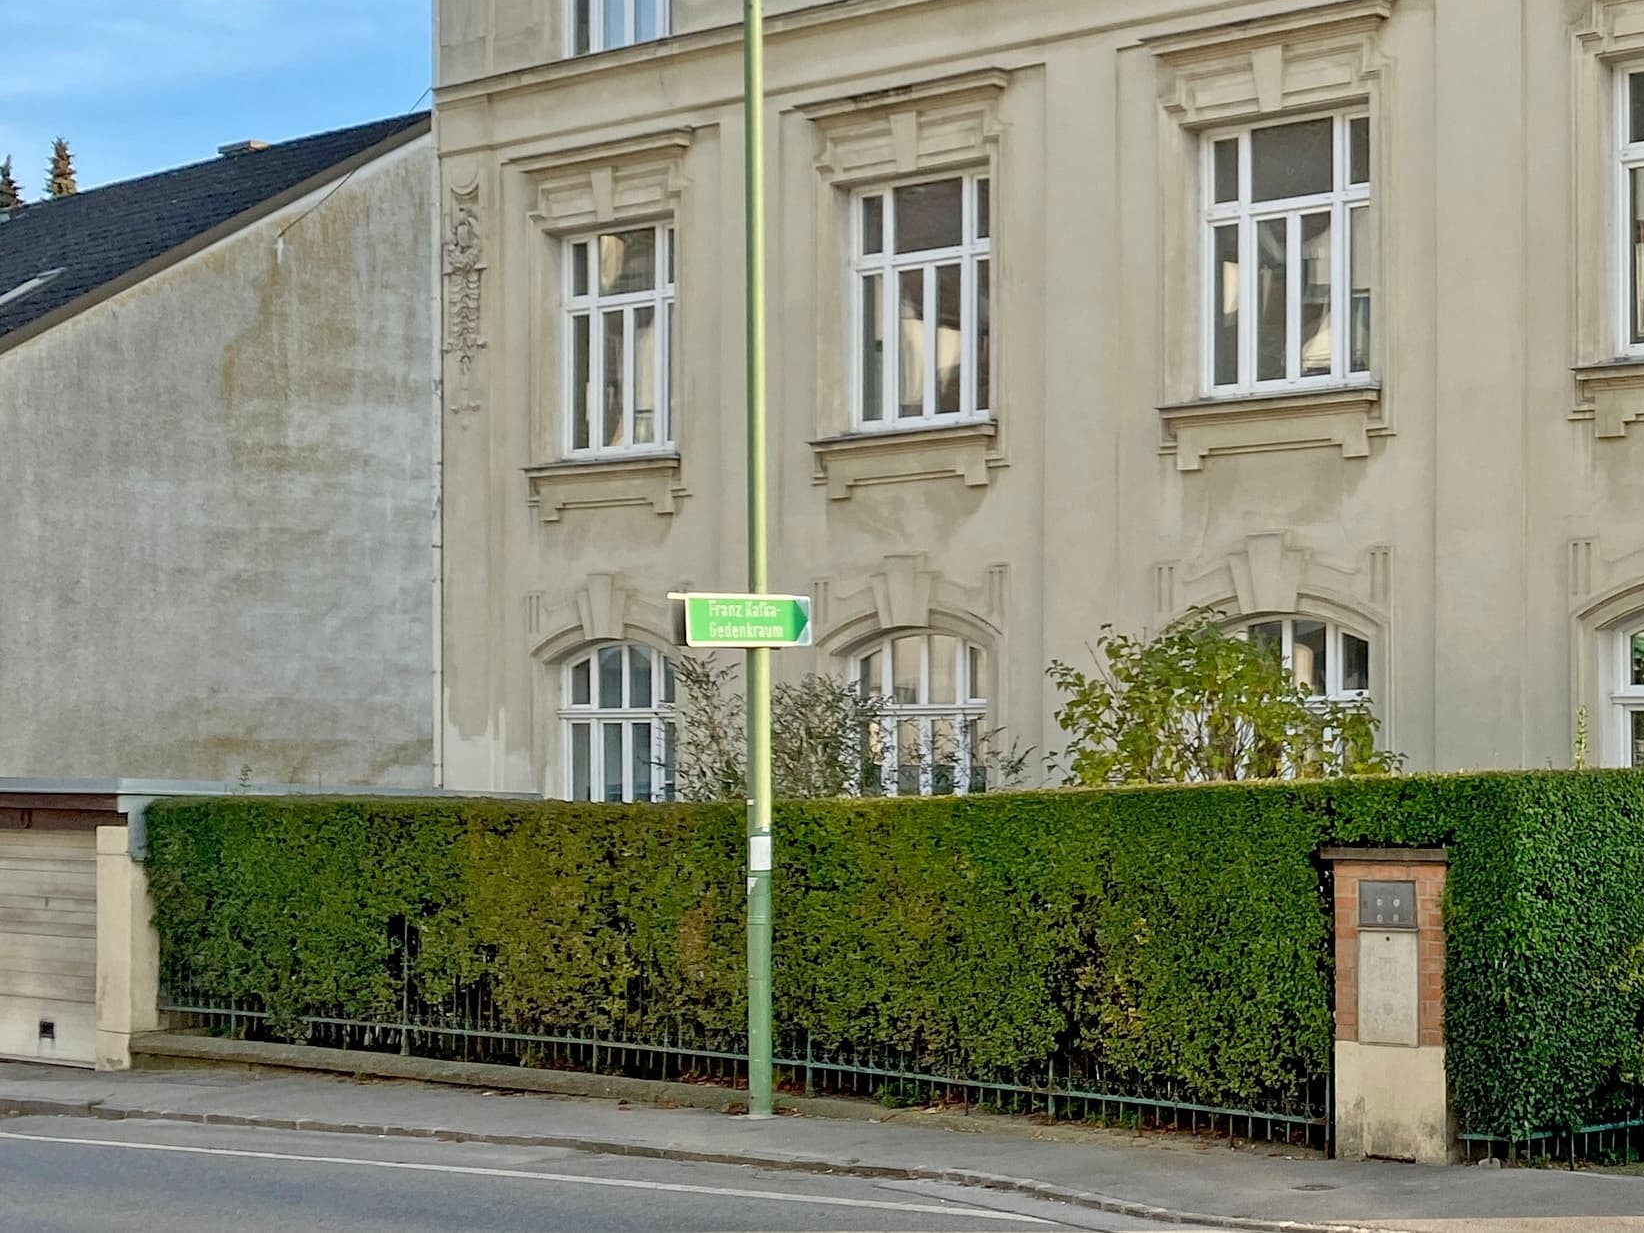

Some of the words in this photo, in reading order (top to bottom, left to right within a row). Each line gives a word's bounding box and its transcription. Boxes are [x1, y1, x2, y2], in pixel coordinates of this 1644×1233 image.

[708, 600, 742, 617] Franz
[745, 601, 782, 618] Kafka-
[709, 621, 784, 638] Gedenkraum
